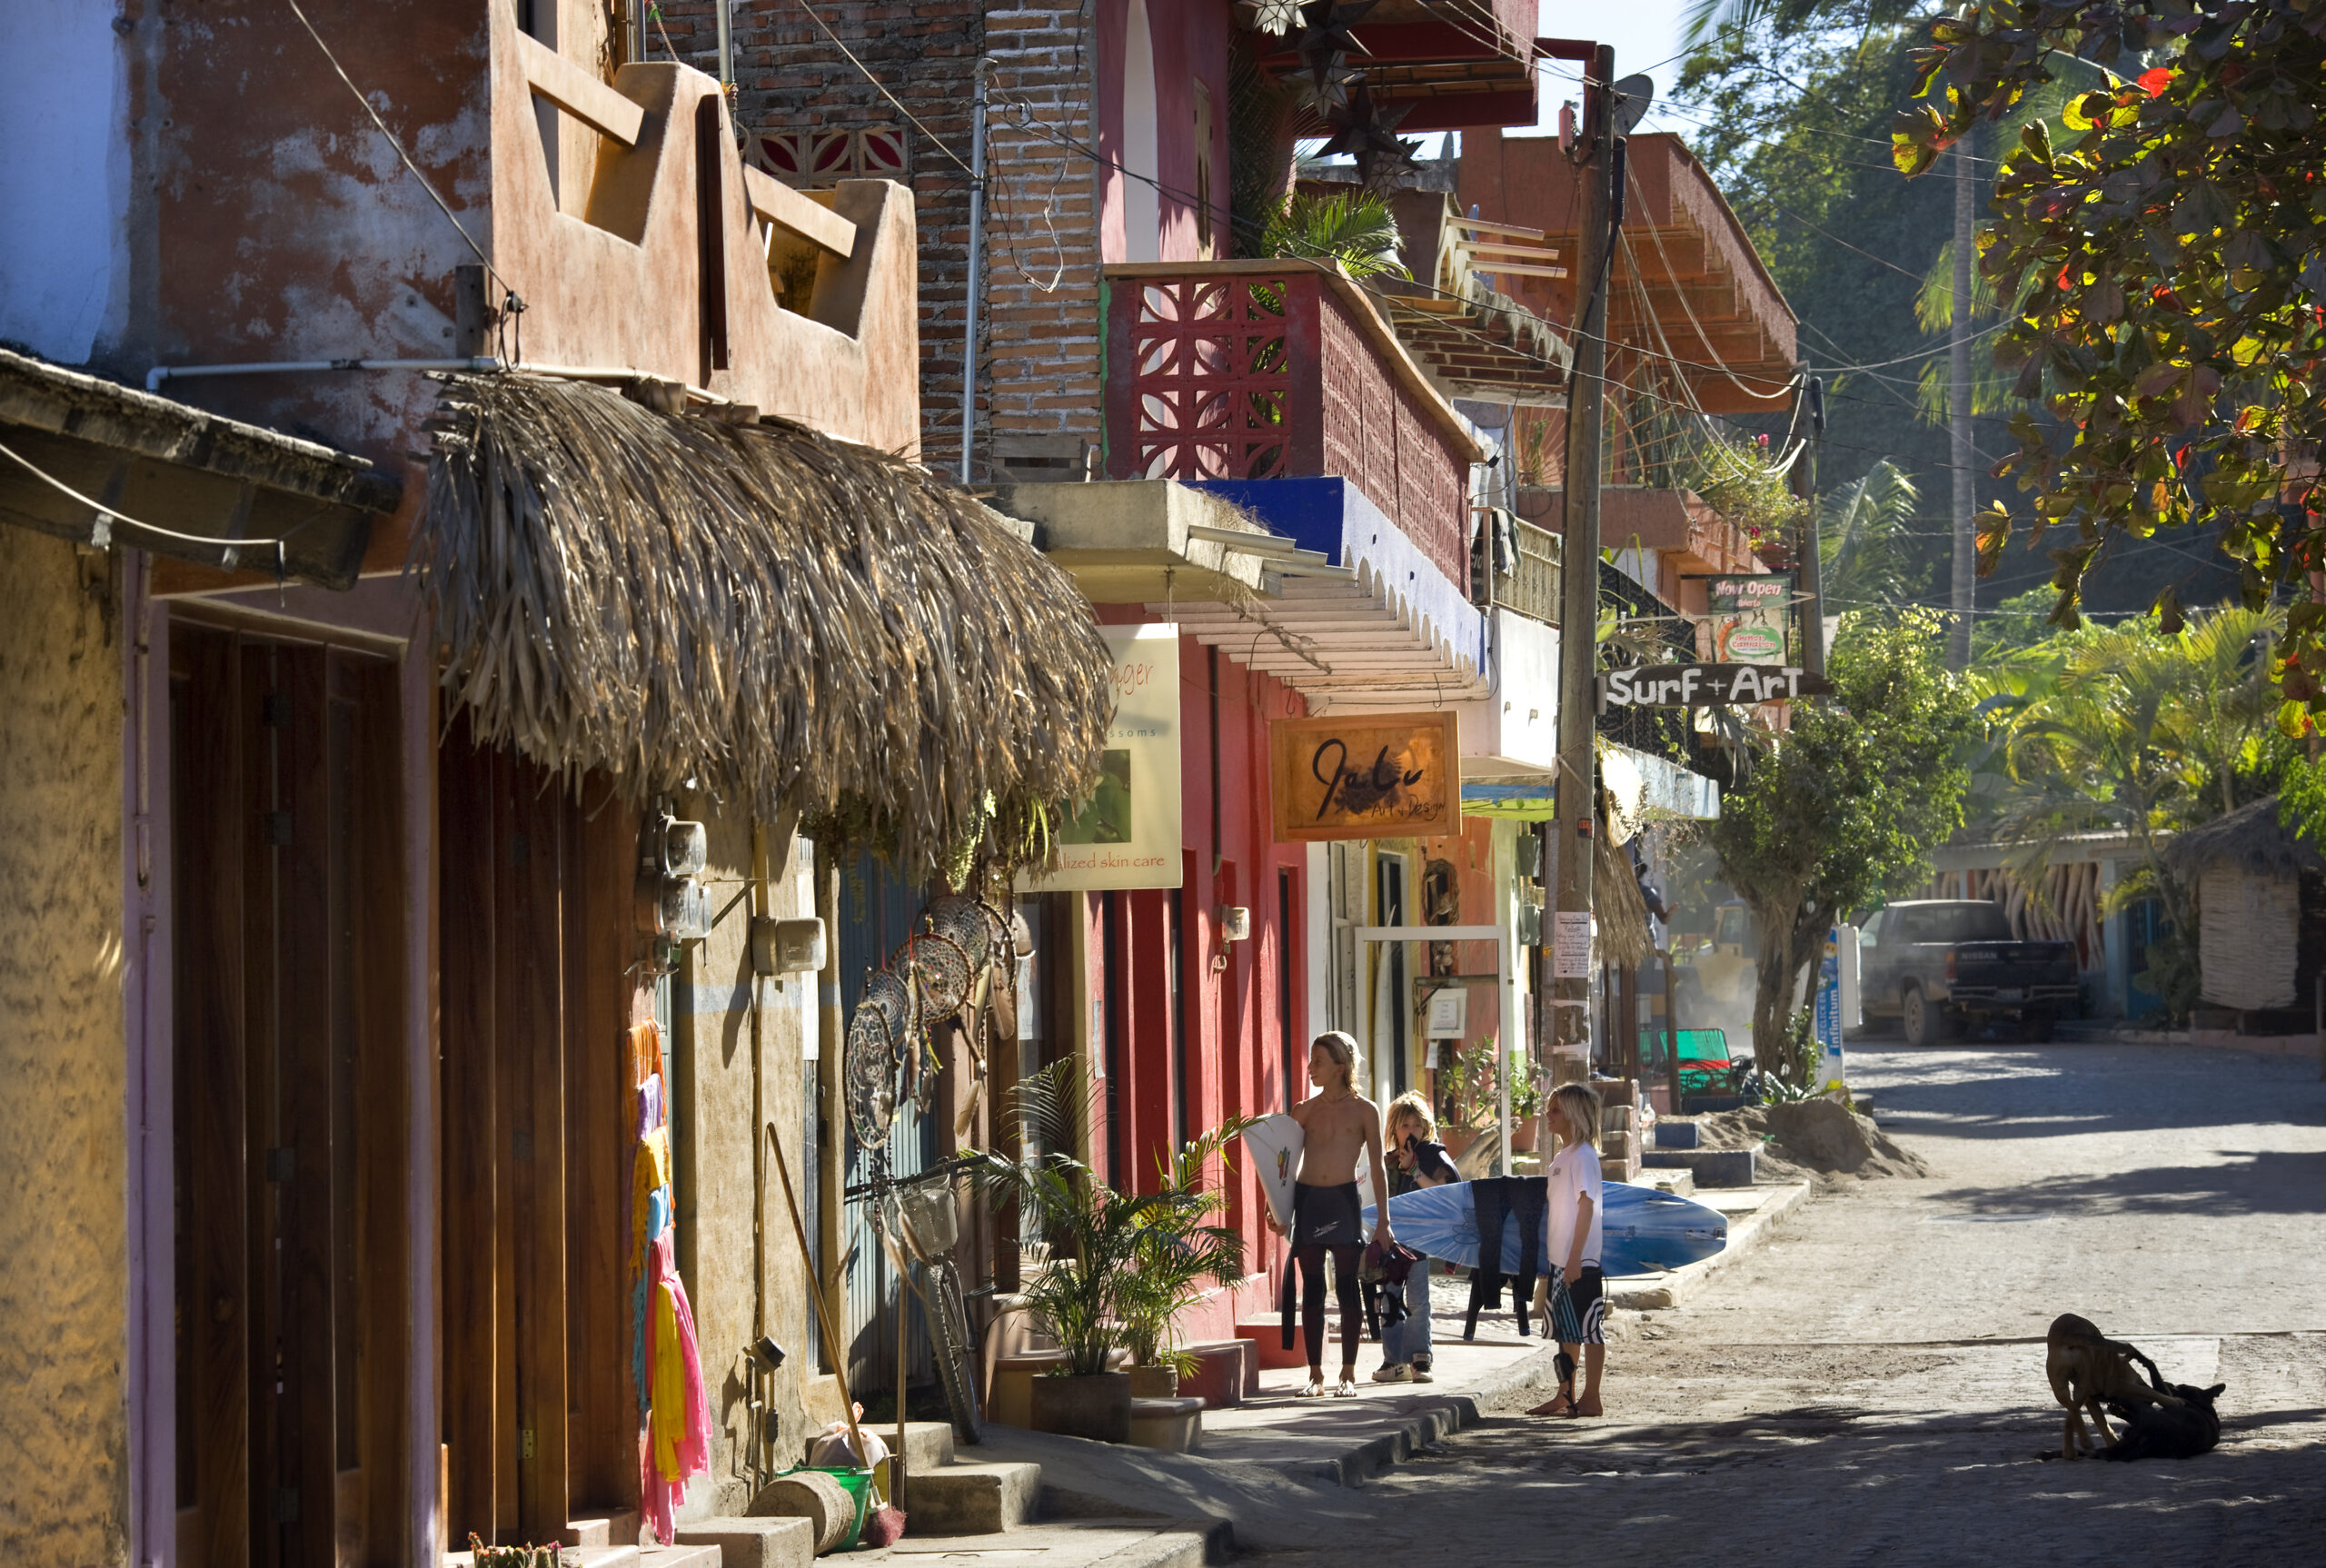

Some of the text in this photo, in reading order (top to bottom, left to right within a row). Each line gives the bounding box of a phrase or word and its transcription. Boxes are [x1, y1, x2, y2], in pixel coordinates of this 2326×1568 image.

[1715, 581, 1782, 598] Now Open
[1109, 663, 1154, 695] nger
[1705, 679, 1726, 696] +
[1109, 729, 1157, 738] ssoms
[1057, 851, 1165, 869] alized skin care
[1961, 951, 1997, 960] NISSAN
[1819, 1005, 1827, 1029] CLICK
[1829, 989, 1840, 1048] infinitum
